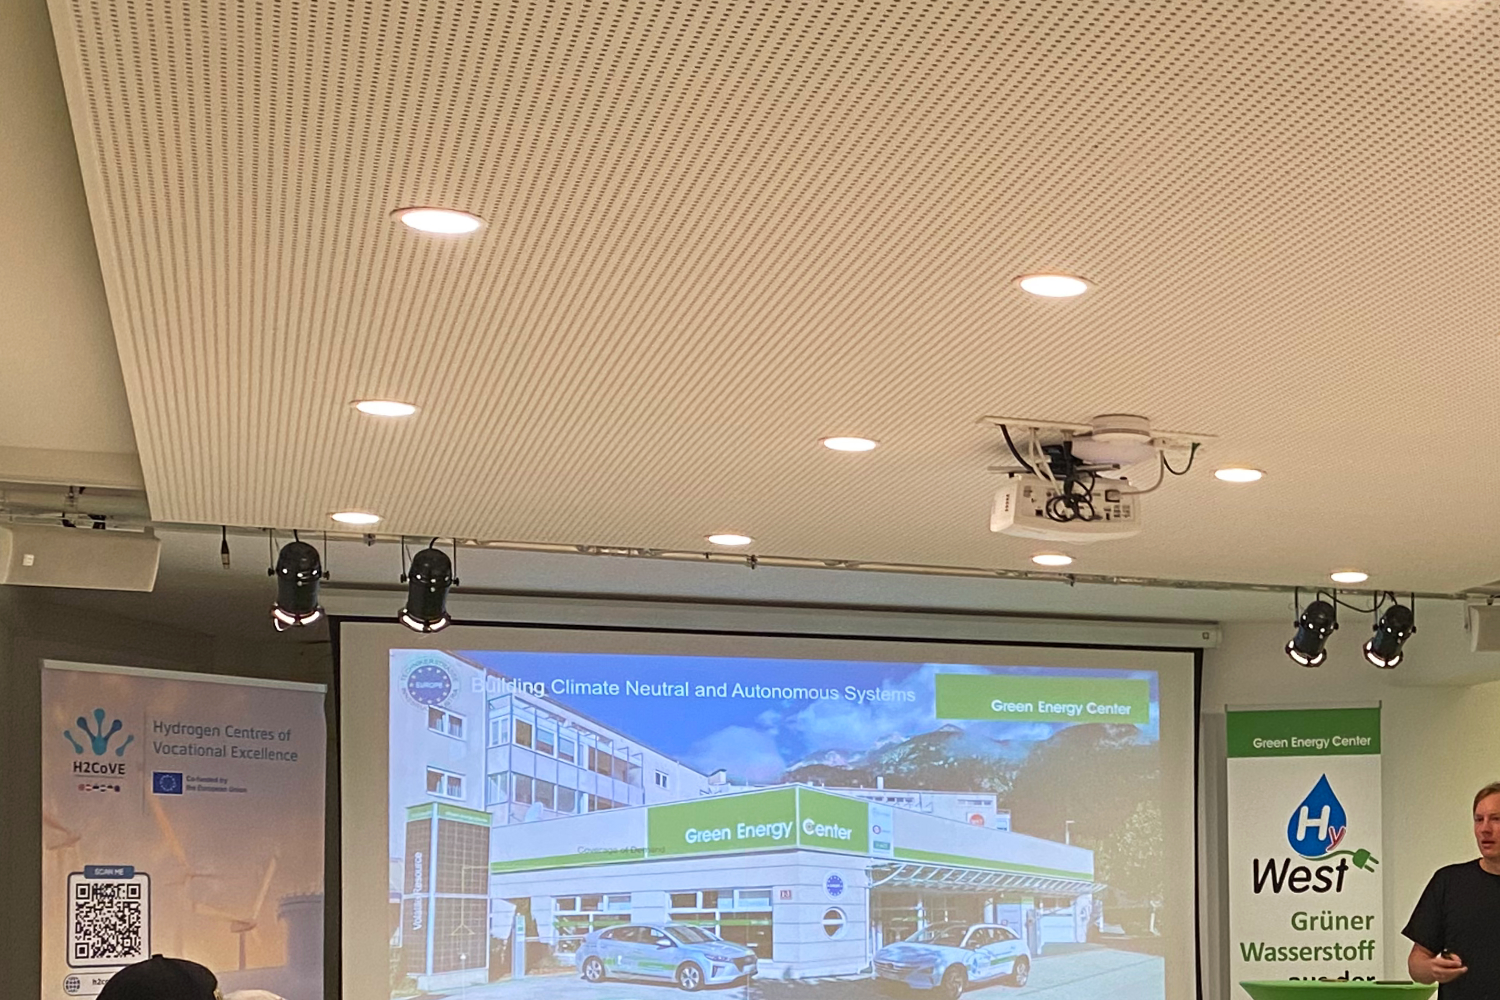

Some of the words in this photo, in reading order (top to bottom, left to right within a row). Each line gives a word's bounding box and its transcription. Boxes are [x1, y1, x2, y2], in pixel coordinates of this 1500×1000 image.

[471, 676, 545, 697] Building
[551, 679, 620, 696] Climate
[626, 680, 689, 697] Neutral
[695, 682, 727, 698] and
[731, 683, 839, 700] Autonomous
[844, 686, 916, 704] Systems
[991, 699, 1033, 712] Green
[1038, 701, 1083, 716] Energy
[1086, 702, 1131, 715] Center
[153, 720, 220, 739] Hydrogen
[225, 725, 275, 741] Centres
[278, 729, 292, 741] of
[153, 741, 226, 758] Vocational
[231, 745, 298, 762] Excellence
[1253, 737, 1288, 749] Green
[1291, 736, 1330, 750] Energy
[1332, 735, 1371, 747] Center
[73, 761, 126, 775] H2CoVE
[685, 827, 731, 844] Green
[737, 821, 793, 840] Energy
[802, 818, 852, 841] Center
[1253, 857, 1349, 894] West
[1291, 910, 1375, 931] Grüner
[1239, 939, 1375, 962] Wasserstoff
